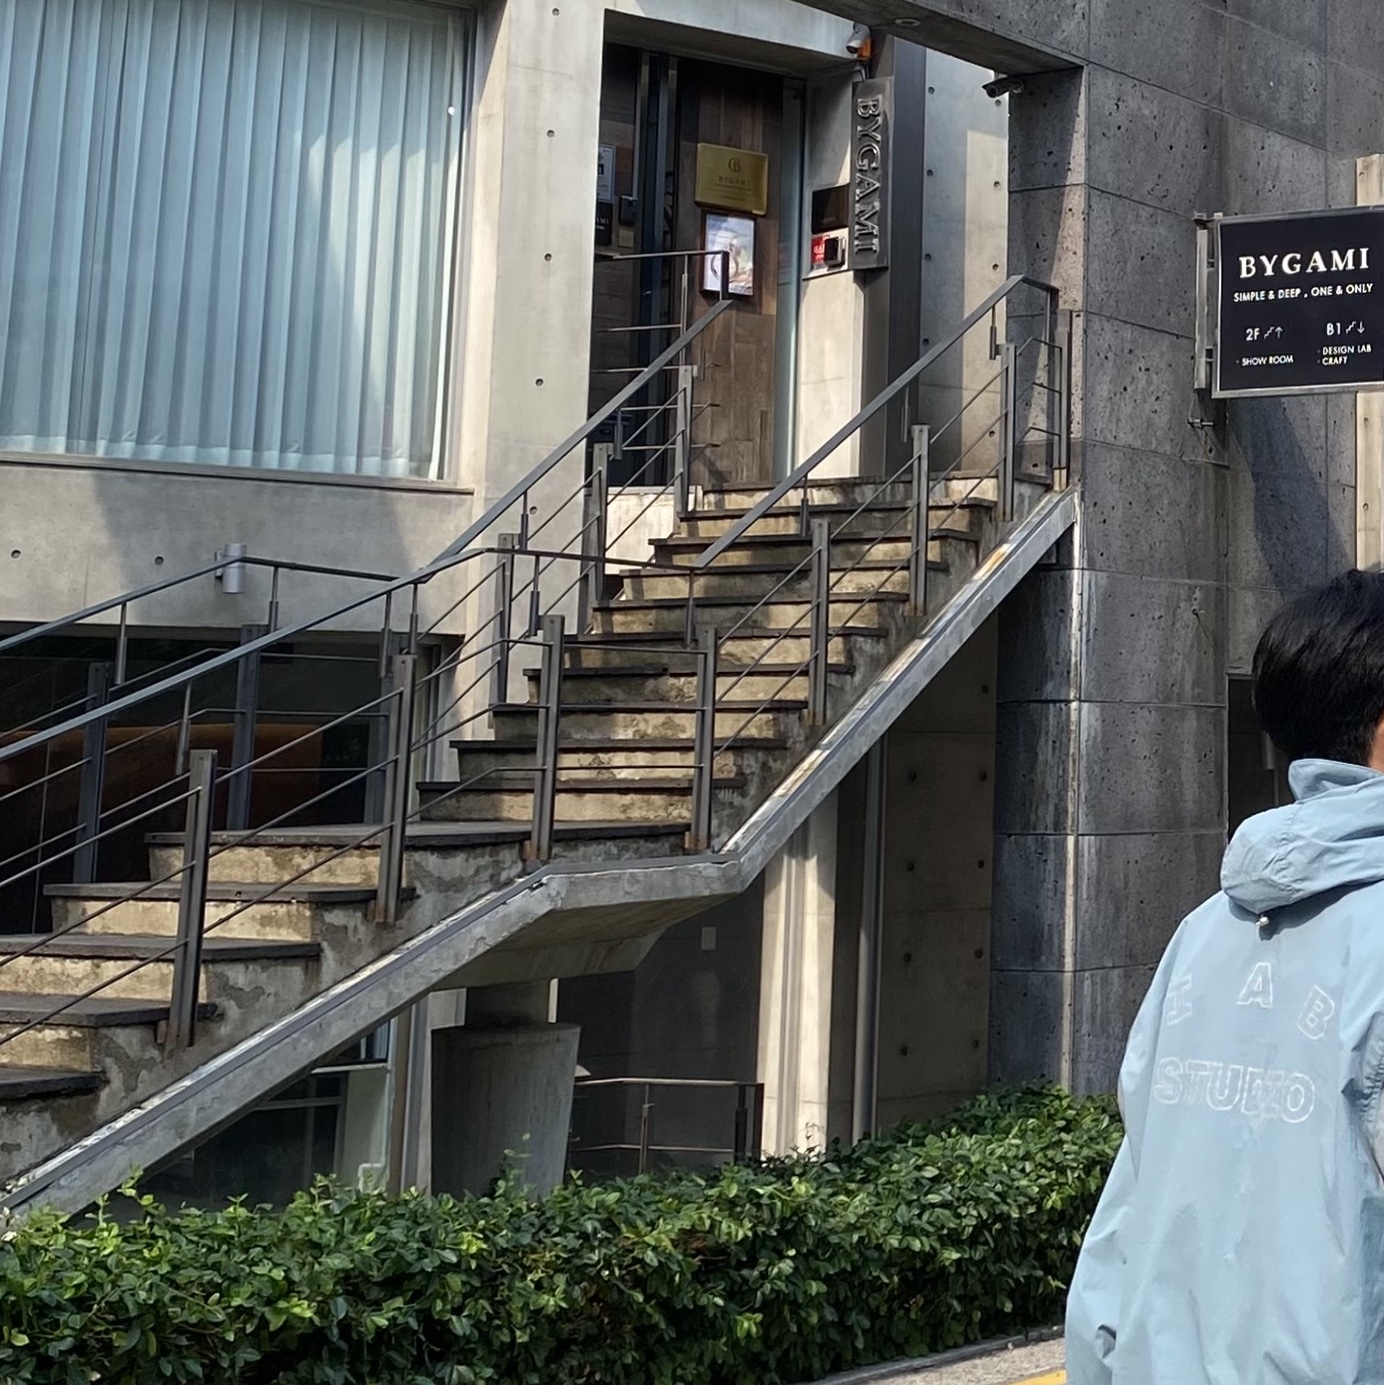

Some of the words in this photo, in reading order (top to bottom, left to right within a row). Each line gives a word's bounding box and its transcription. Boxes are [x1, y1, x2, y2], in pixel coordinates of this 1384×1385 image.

[855, 94, 882, 254] BYGAMI
[1238, 248, 1370, 278] BYGAMI
[1233, 290, 1266, 302] SIMPLE
[1268, 289, 1276, 300] &
[1311, 286, 1333, 297] ONE
[1336, 285, 1343, 295] &
[1345, 283, 1374, 295] ONLY
[1245, 328, 1260, 341] 2F
[1326, 322, 1342, 336] B1
[1322, 345, 1354, 355] DESIGN
[1357, 344, 1372, 354] LAB
[1241, 356, 1267, 366] SHOW
[1268, 354, 1294, 364] ROOM
[1322, 355, 1348, 366] CRAFT
[1154, 1056, 1316, 1123] STUDIO
